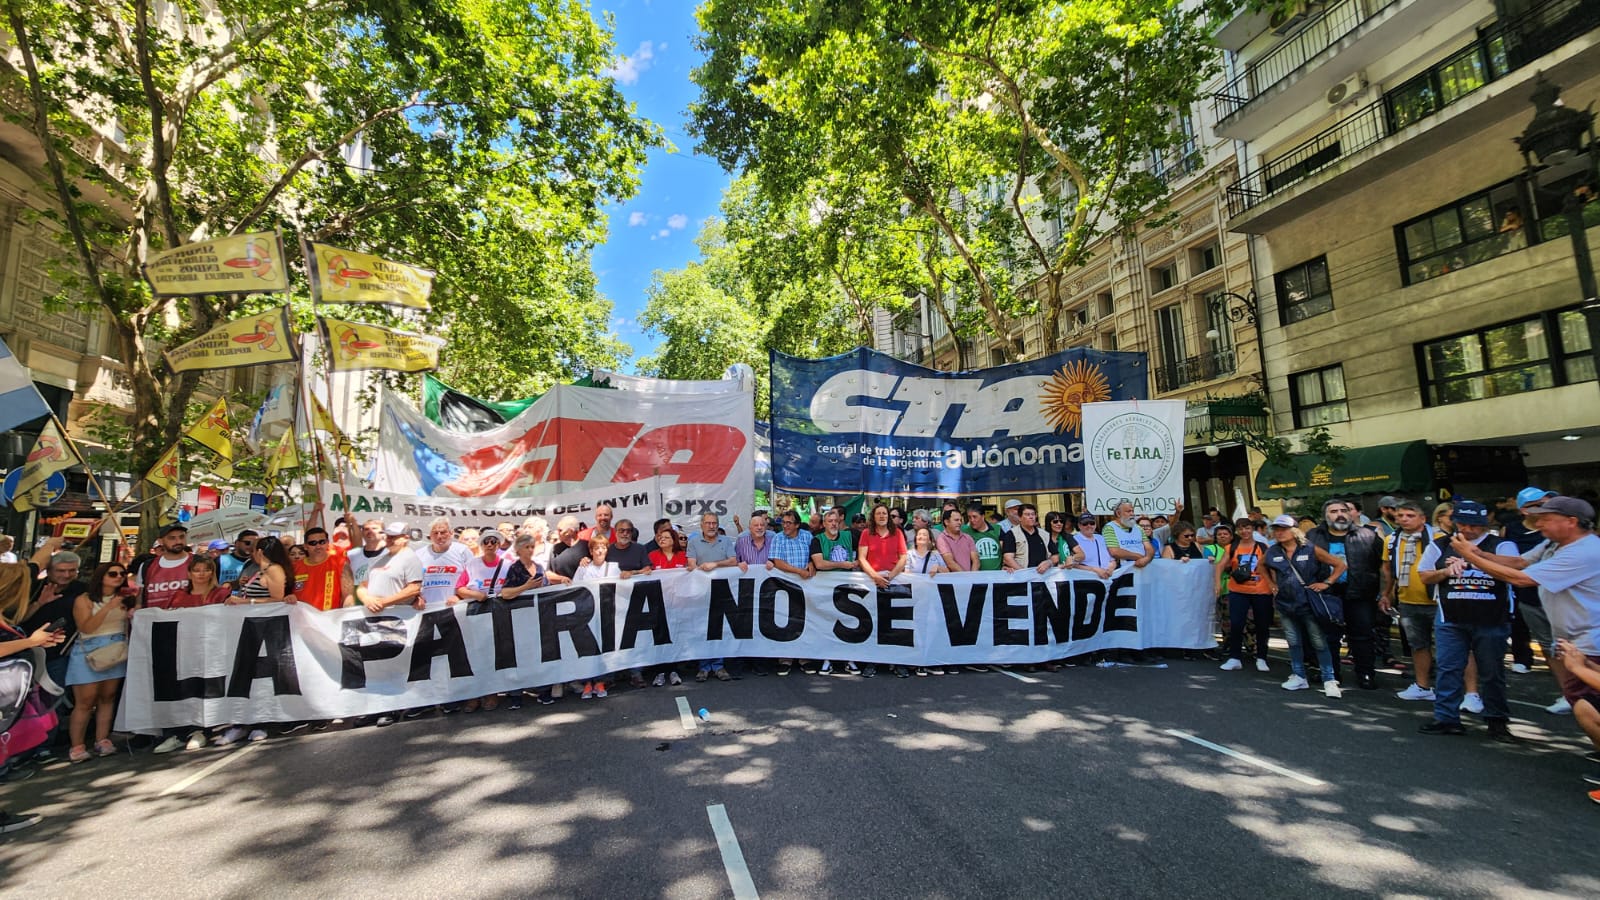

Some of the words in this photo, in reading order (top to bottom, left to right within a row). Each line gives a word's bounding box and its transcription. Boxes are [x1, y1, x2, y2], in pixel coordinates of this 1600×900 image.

[810, 369, 1056, 438] CTA
[444, 417, 747, 497] CTA
[816, 442, 857, 454] central
[859, 443, 873, 454] de
[874, 444, 942, 460] trabajadorxs
[863, 456, 876, 466] de
[878, 456, 887, 466] la
[890, 458, 943, 470] argentina
[945, 443, 1084, 470] autónoma
[553, 502, 591, 515] DEL
[152, 614, 303, 701] LA
[339, 579, 673, 689] PATRIA
[706, 576, 806, 642] NO
[832, 583, 915, 648] SE
[937, 572, 1138, 647] VENDE
